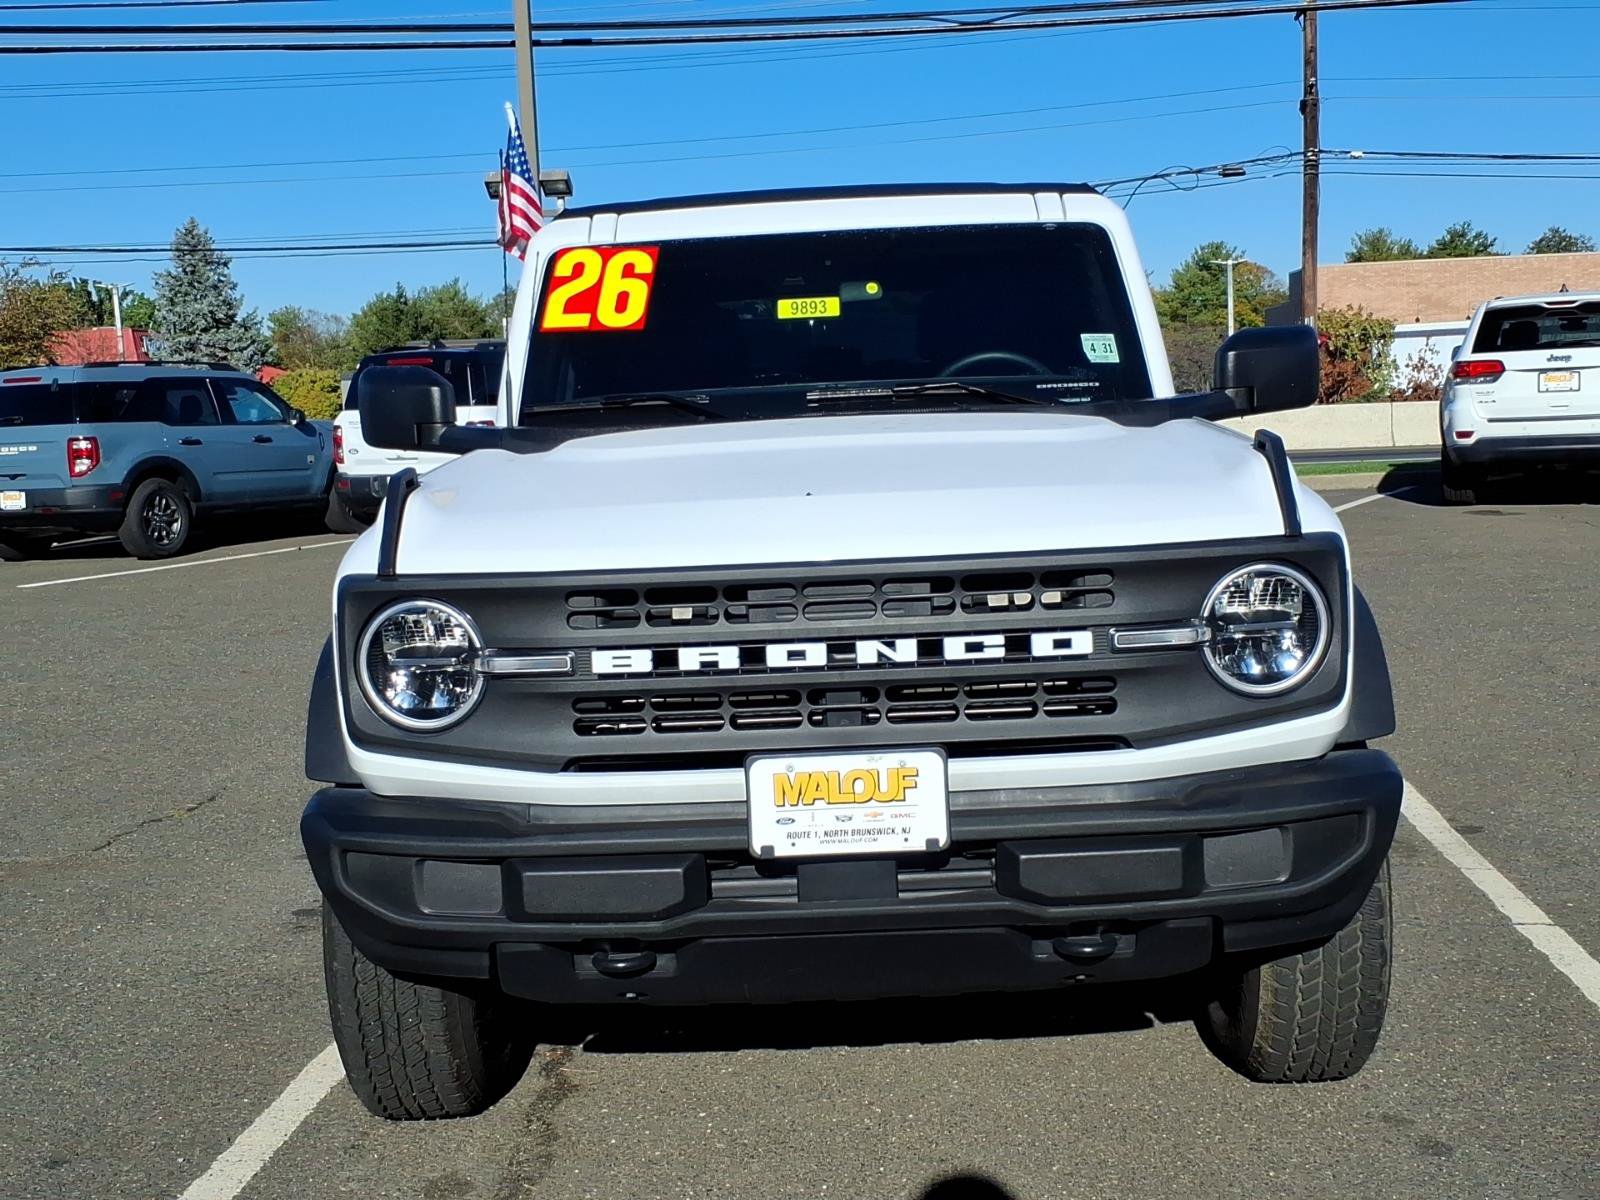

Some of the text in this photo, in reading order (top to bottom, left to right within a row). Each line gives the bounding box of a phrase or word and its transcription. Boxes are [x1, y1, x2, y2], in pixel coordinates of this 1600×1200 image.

[542, 248, 653, 328] 26
[790, 300, 827, 315] 9893
[1090, 342, 1114, 354] 4 31
[591, 630, 1093, 674] BRONCO
[773, 767, 919, 806] MALOUF
[786, 826, 911, 840] ROUTE 1, NORTH BRUNSWICK, NJ
